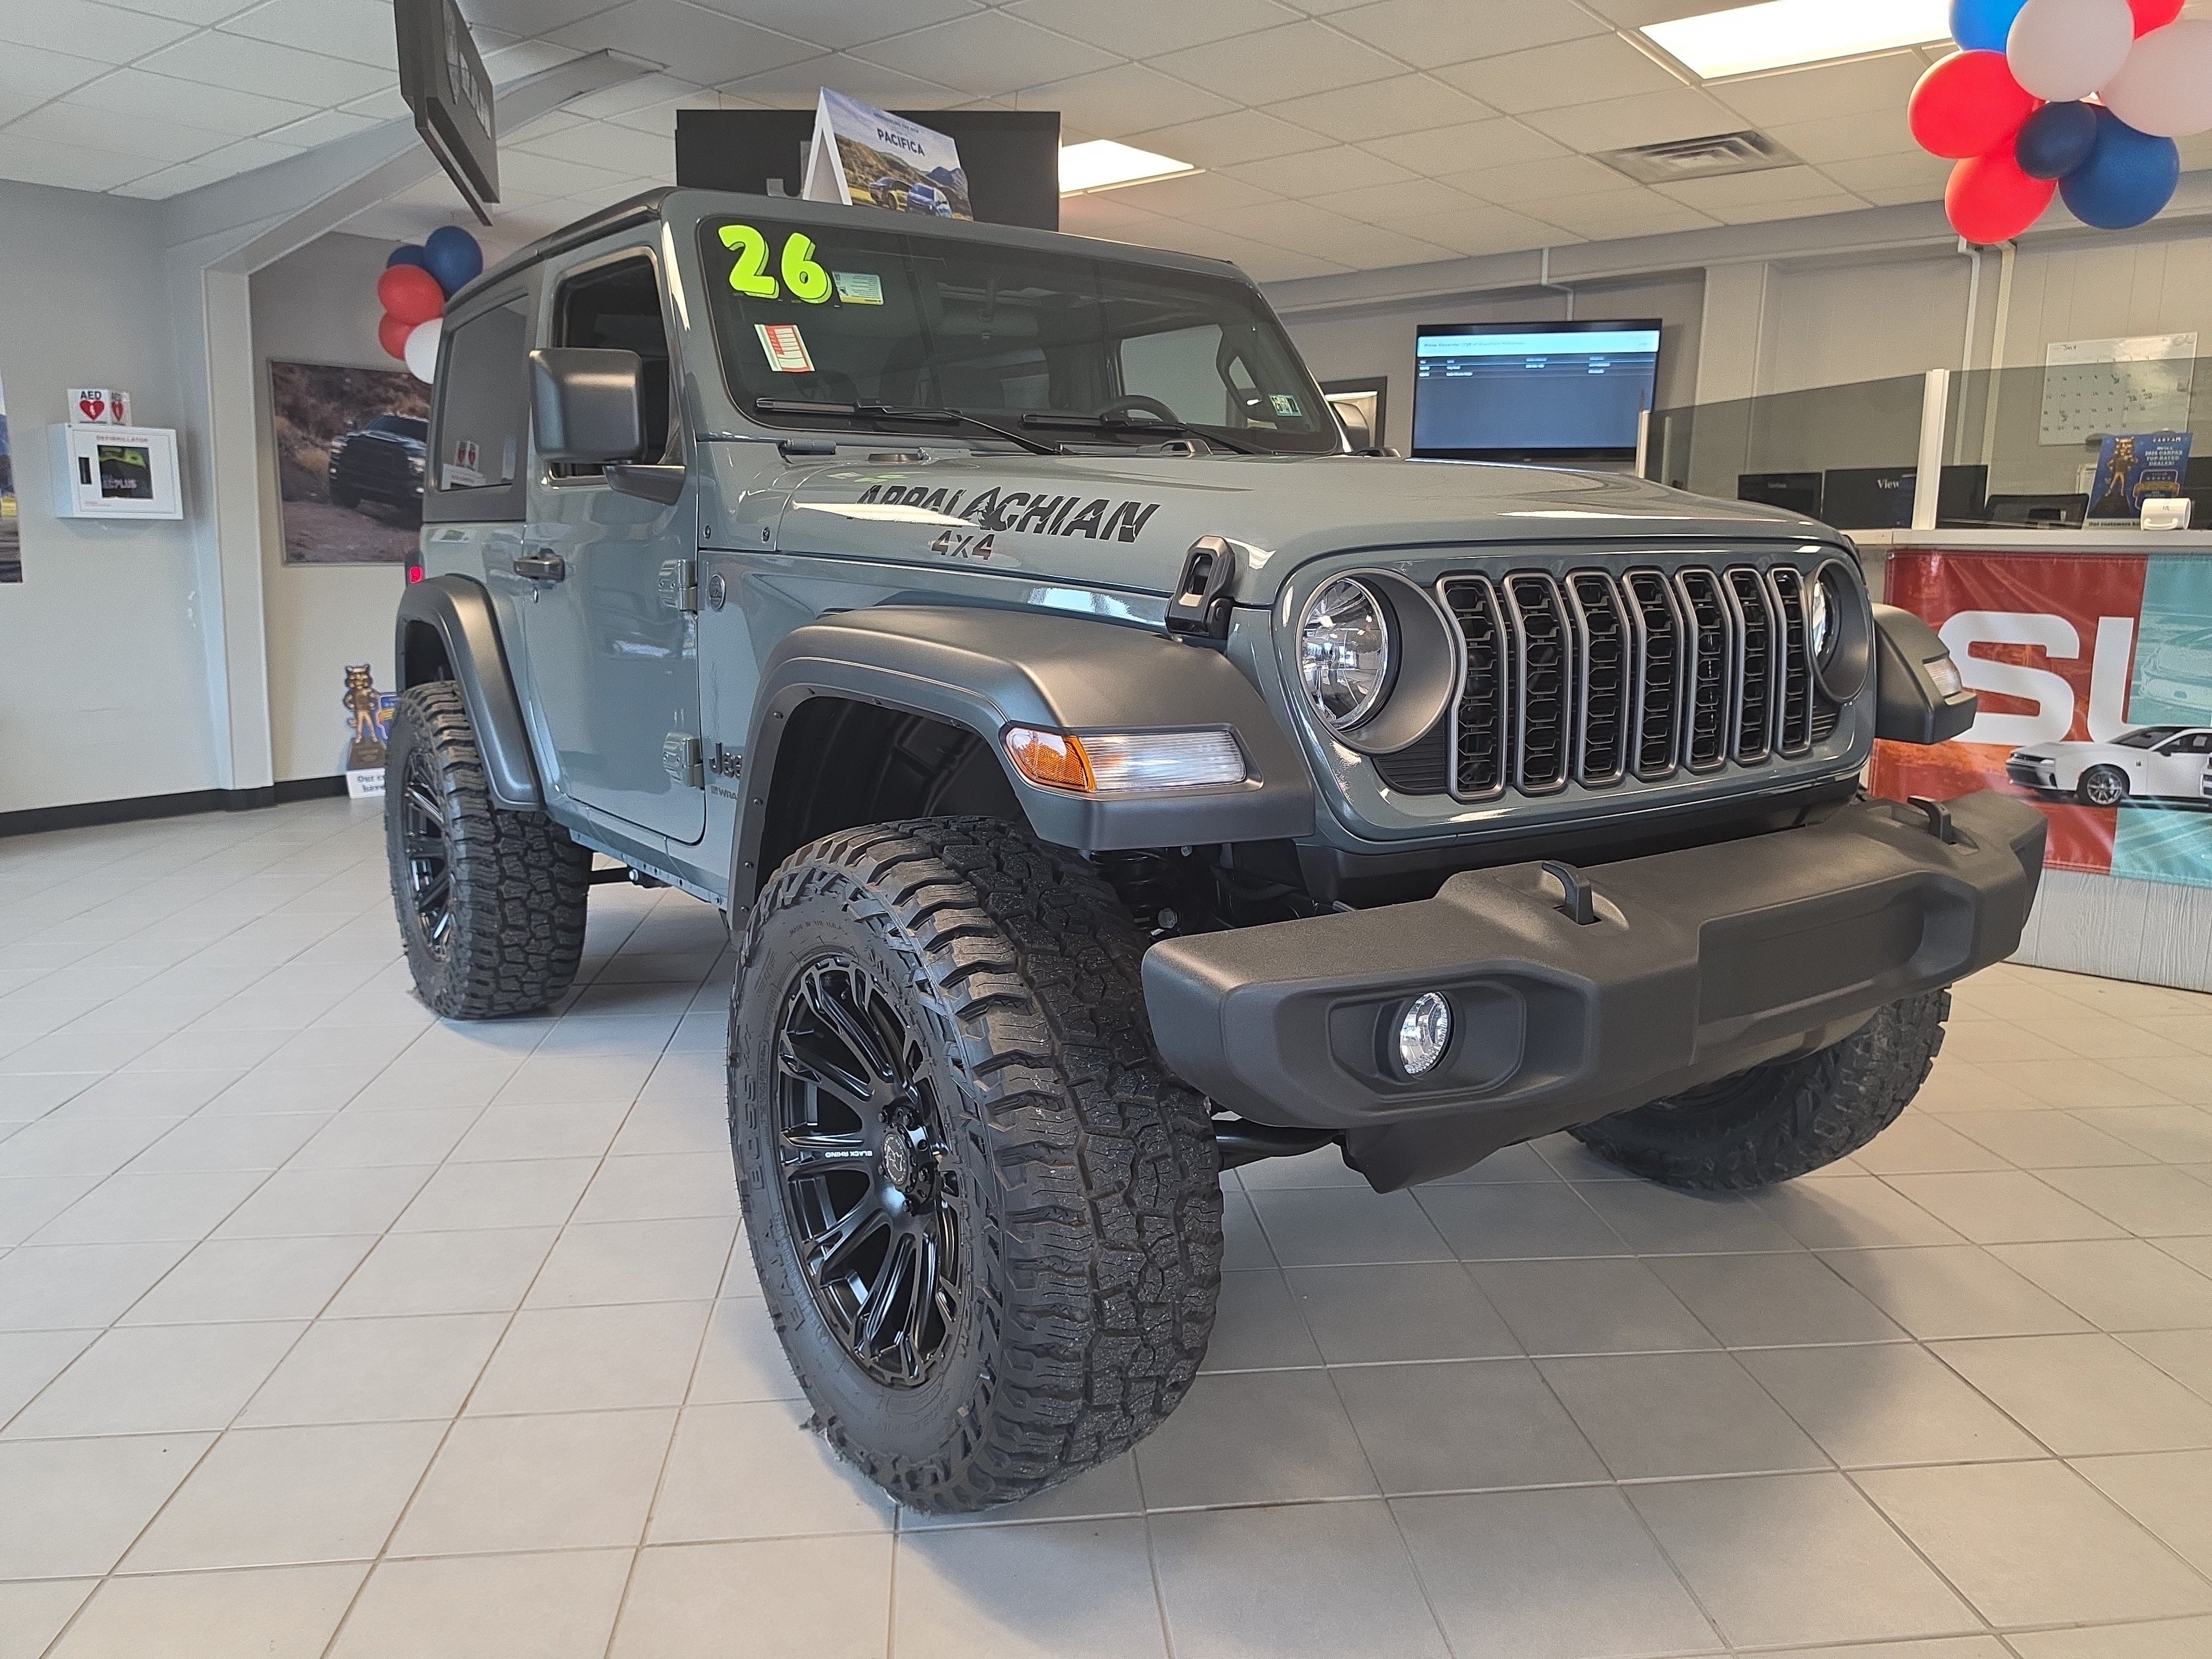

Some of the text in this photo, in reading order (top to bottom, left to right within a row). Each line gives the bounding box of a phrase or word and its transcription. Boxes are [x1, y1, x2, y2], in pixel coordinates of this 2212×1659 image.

[877, 127, 925, 157] PACIFICA
[718, 224, 833, 304] 26
[80, 391, 102, 400] AED
[850, 485, 1161, 543] APPALACHIAN
[709, 742, 742, 780] Jee
[744, 1073, 765, 1189] BOSS
